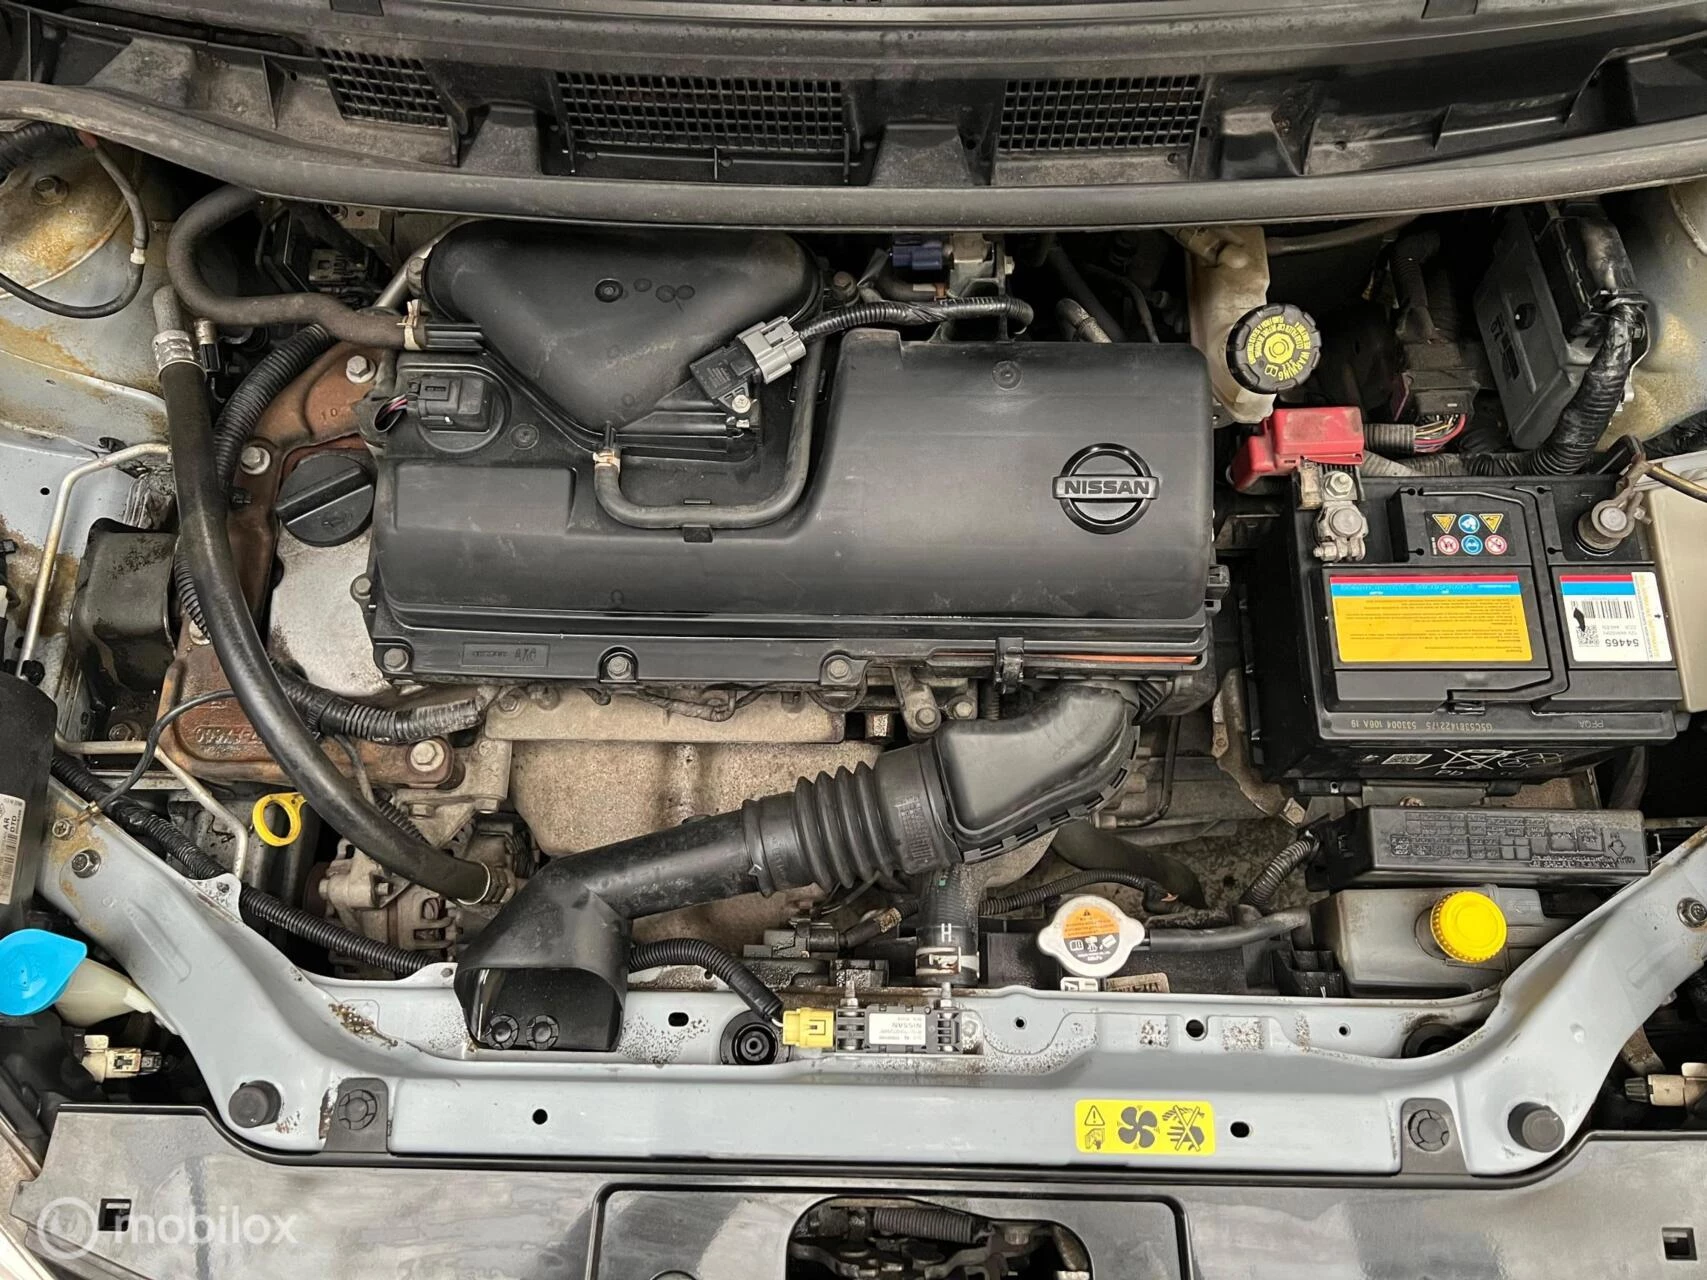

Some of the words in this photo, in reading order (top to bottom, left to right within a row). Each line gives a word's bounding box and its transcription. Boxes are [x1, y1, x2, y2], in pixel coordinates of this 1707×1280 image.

[1278, 351, 1311, 381] WARNING
[1064, 480, 1150, 495] NISSAN
[1604, 638, 1639, 647] 54465
[3, 817, 11, 829] AR
[941, 922, 952, 943] H
